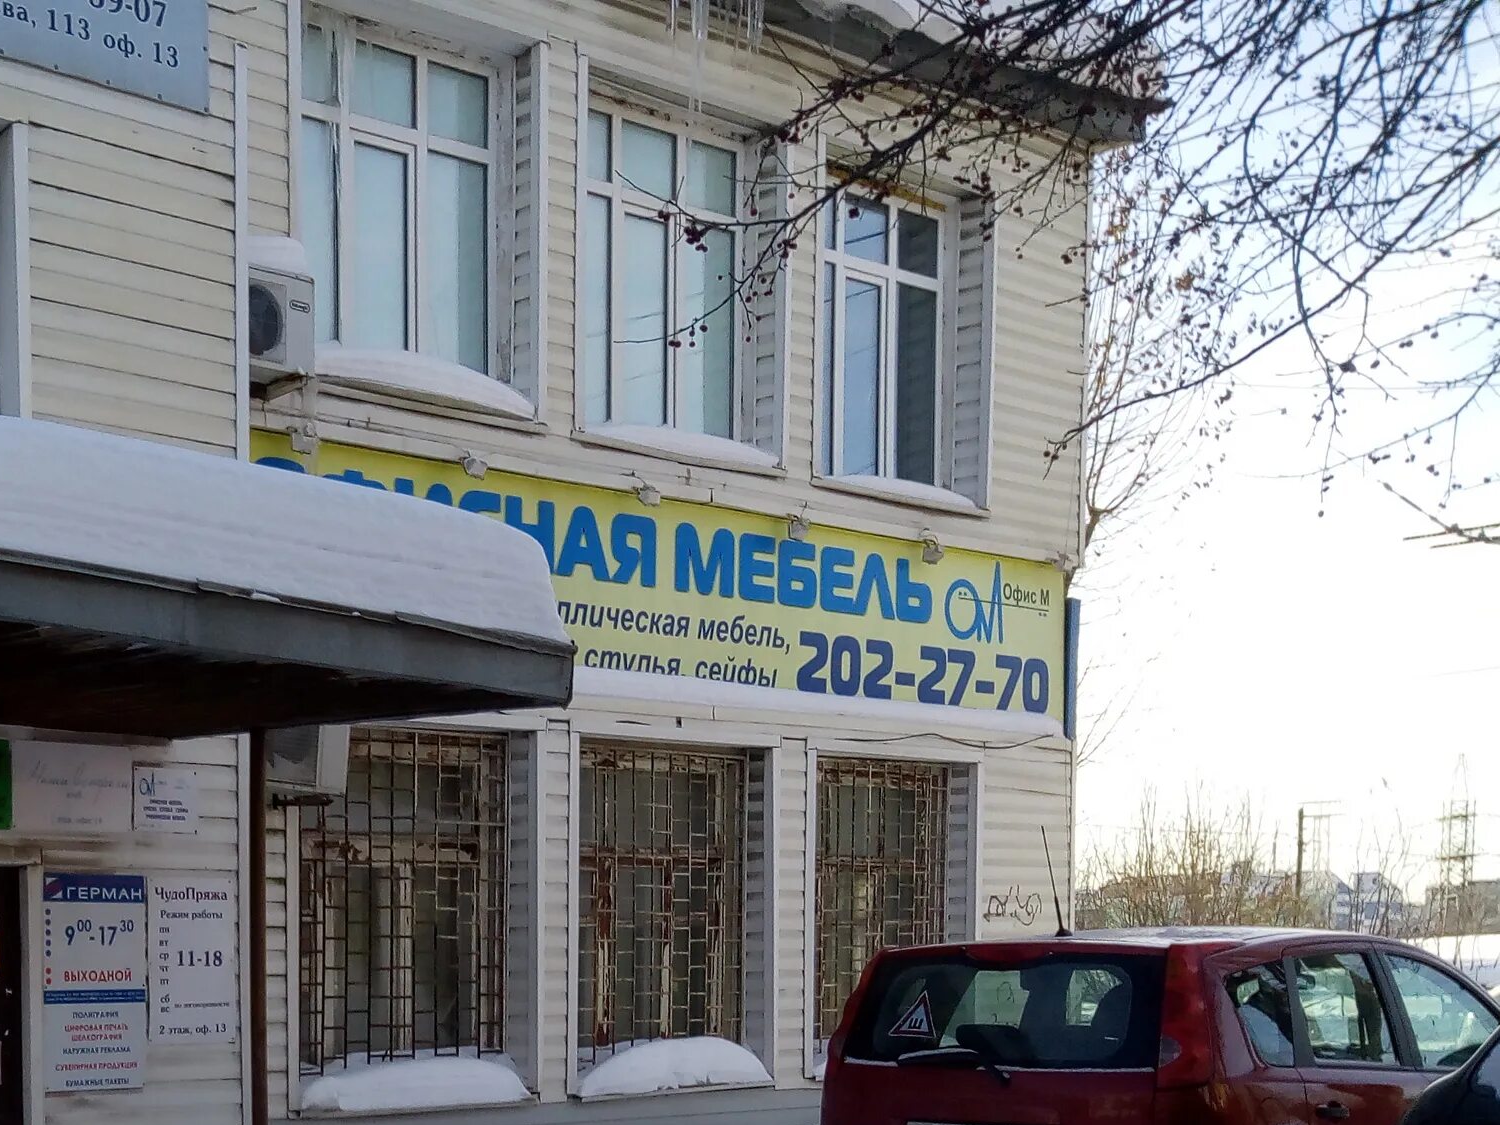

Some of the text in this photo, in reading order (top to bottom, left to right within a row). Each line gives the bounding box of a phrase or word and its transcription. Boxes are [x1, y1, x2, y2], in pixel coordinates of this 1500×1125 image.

[48, 8, 91, 40] 113
[103, 32, 143, 58] оф.
[153, 42, 180, 68] 13
[674, 521, 933, 624] МЕБЕЛЬ
[1003, 582, 1050, 606] Офис М
[698, 615, 790, 654] мебель,
[695, 656, 778, 688] сейфы
[796, 631, 1049, 714] 202-27-70
[67, 887, 142, 900] ГЕРМАН
[155, 887, 228, 903] ЧудоПряжа
[160, 909, 223, 921] Режим работы
[159, 952, 170, 961] ср
[177, 950, 223, 968] 11-18
[64, 968, 132, 983] ВЫХОДНОЙ
[72, 1011, 119, 1019] ПОЛИГРАФИЯ
[159, 1025, 165, 1035] 2
[215, 1023, 227, 1034] 13
[100, 1045, 131, 1053] РЕКЛАМА
